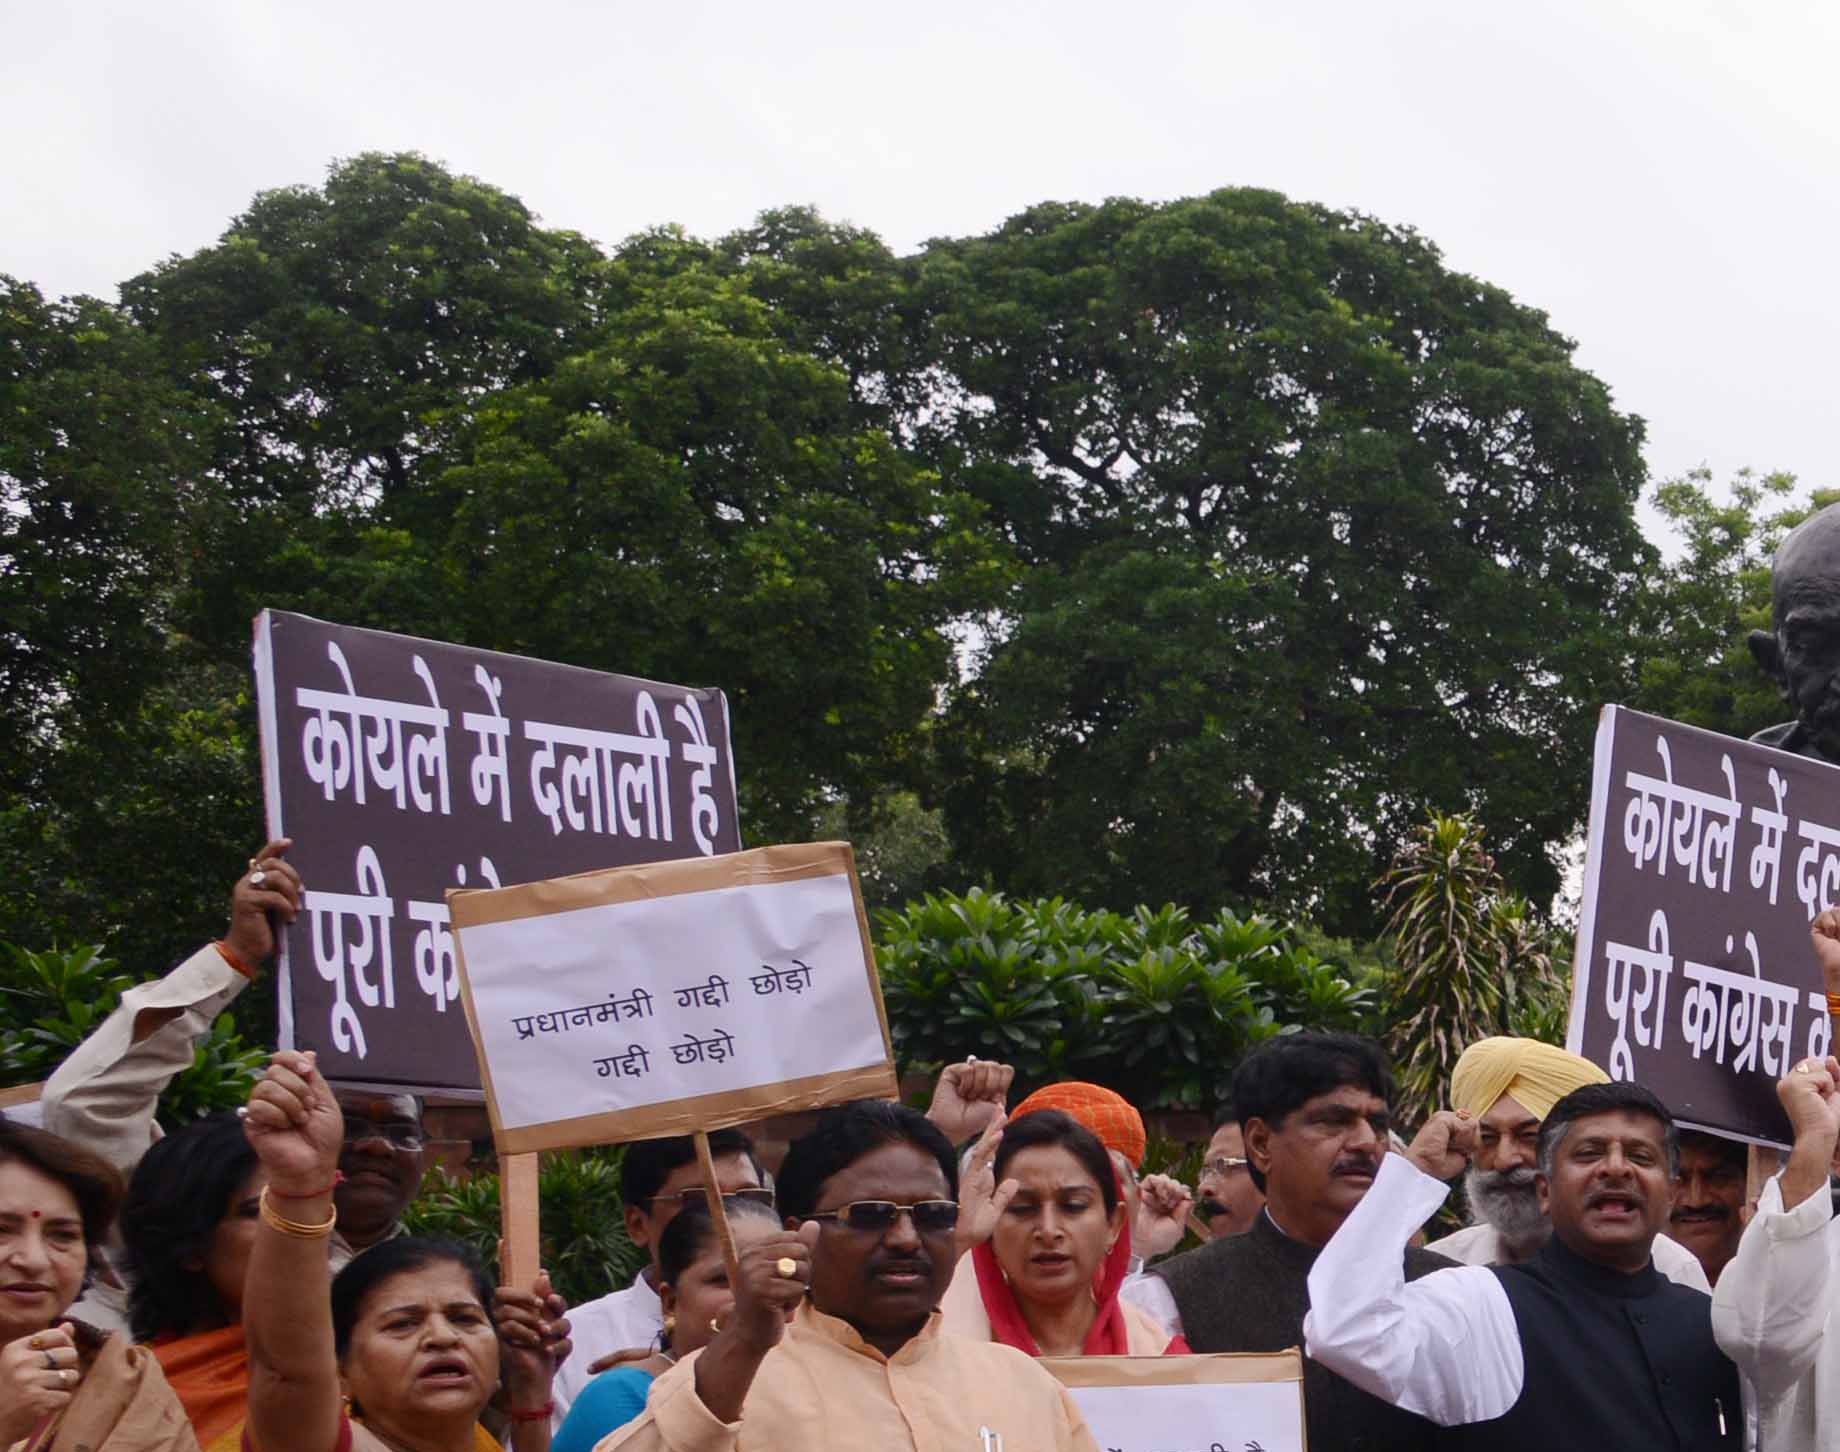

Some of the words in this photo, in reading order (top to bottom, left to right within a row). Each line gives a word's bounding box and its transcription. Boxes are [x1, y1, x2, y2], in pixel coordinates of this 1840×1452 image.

[296, 641, 450, 815] कोयले
[463, 664, 512, 822] में
[524, 691, 672, 842] दलाली
[674, 694, 719, 856] है
[1623, 735, 1742, 892] कोयले
[1748, 767, 1789, 905] में
[305, 845, 395, 1060] पूरी
[511, 987, 655, 1041] प्रधानमंत्री
[673, 974, 731, 1010] गद्दी
[748, 960, 814, 996] छोड़ो
[1604, 909, 1674, 1082] पूरी
[1681, 930, 1799, 1079] कांग्रेस
[593, 1045, 651, 1080] गद्दी
[669, 1028, 737, 1064] छोड़ो
